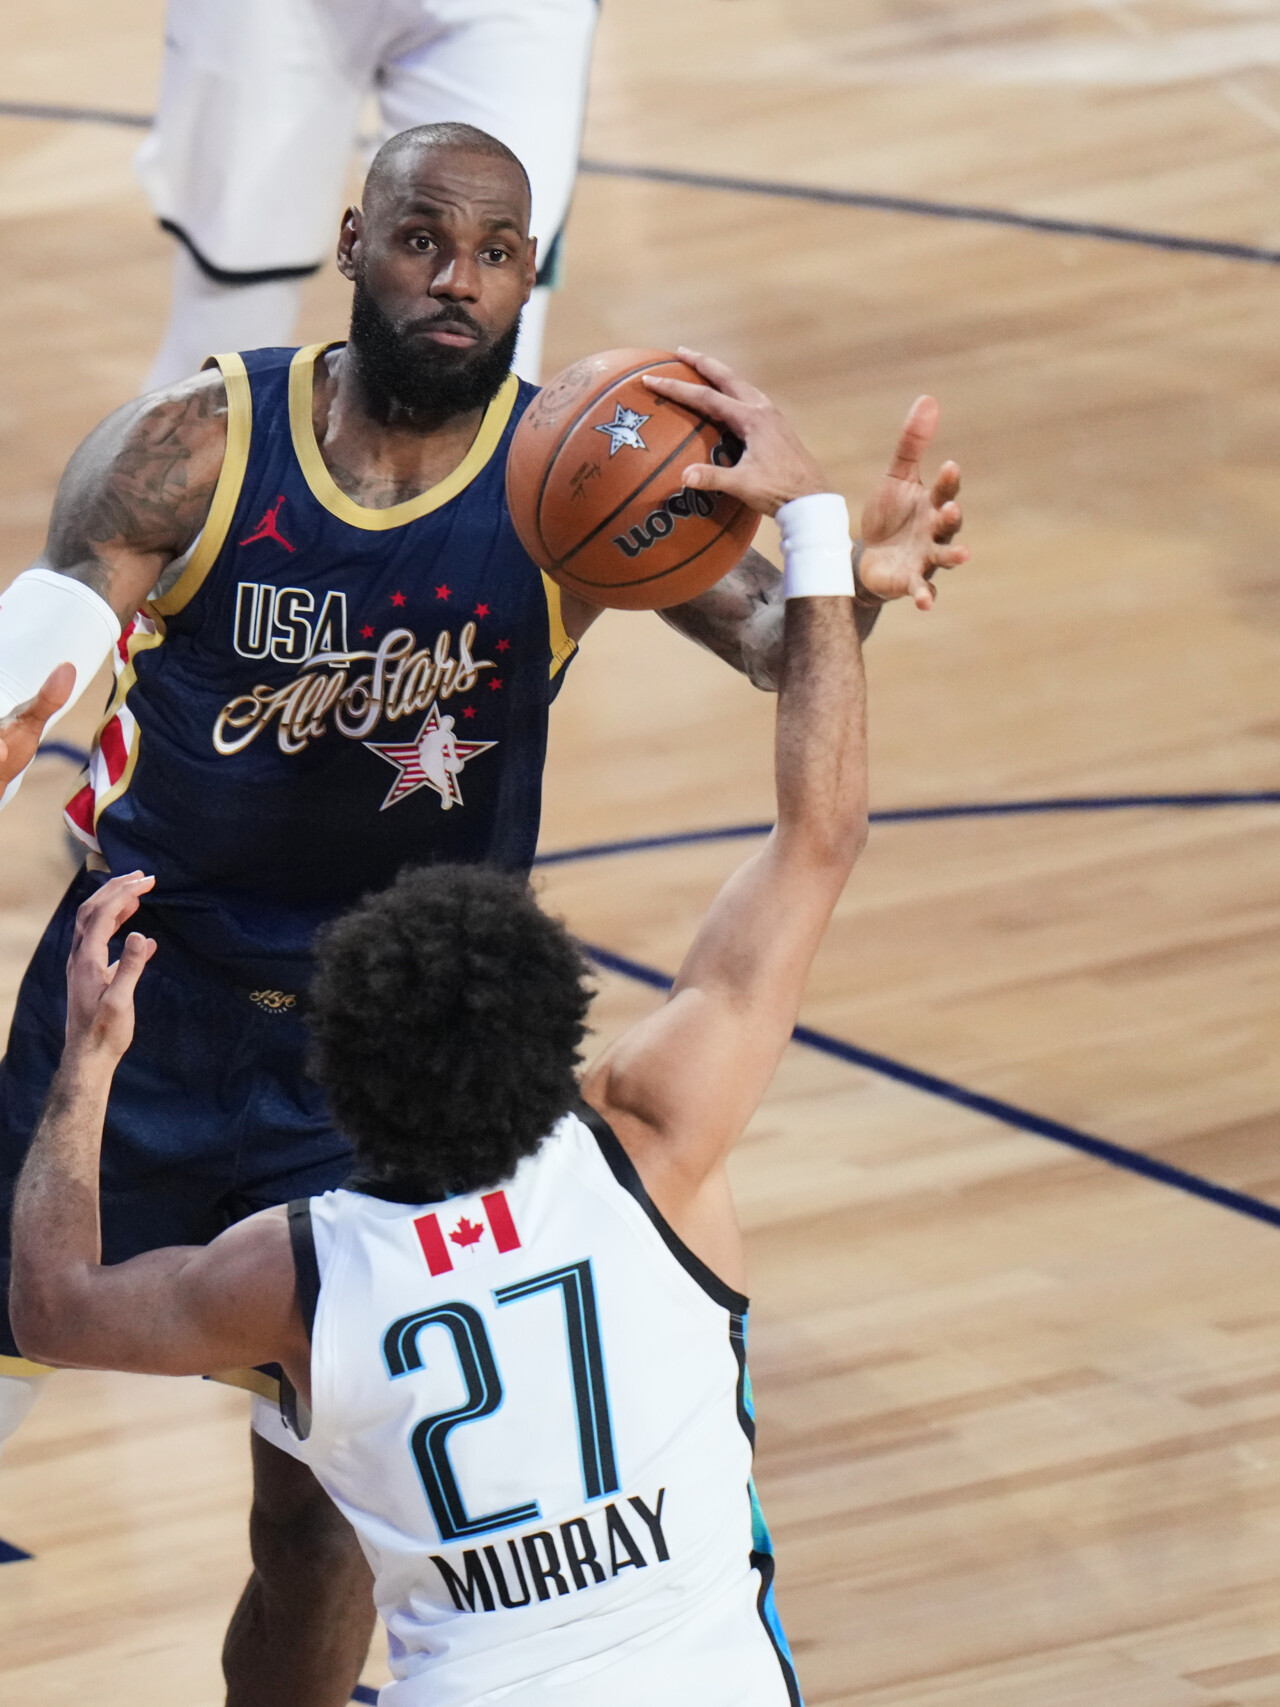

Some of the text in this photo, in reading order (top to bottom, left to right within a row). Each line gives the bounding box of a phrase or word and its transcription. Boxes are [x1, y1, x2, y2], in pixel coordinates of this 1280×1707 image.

[212, 621, 497, 756] All Stars
[233, 582, 351, 668] USA
[380, 1256, 621, 1544] 27
[429, 1487, 671, 1614] MURRAY
